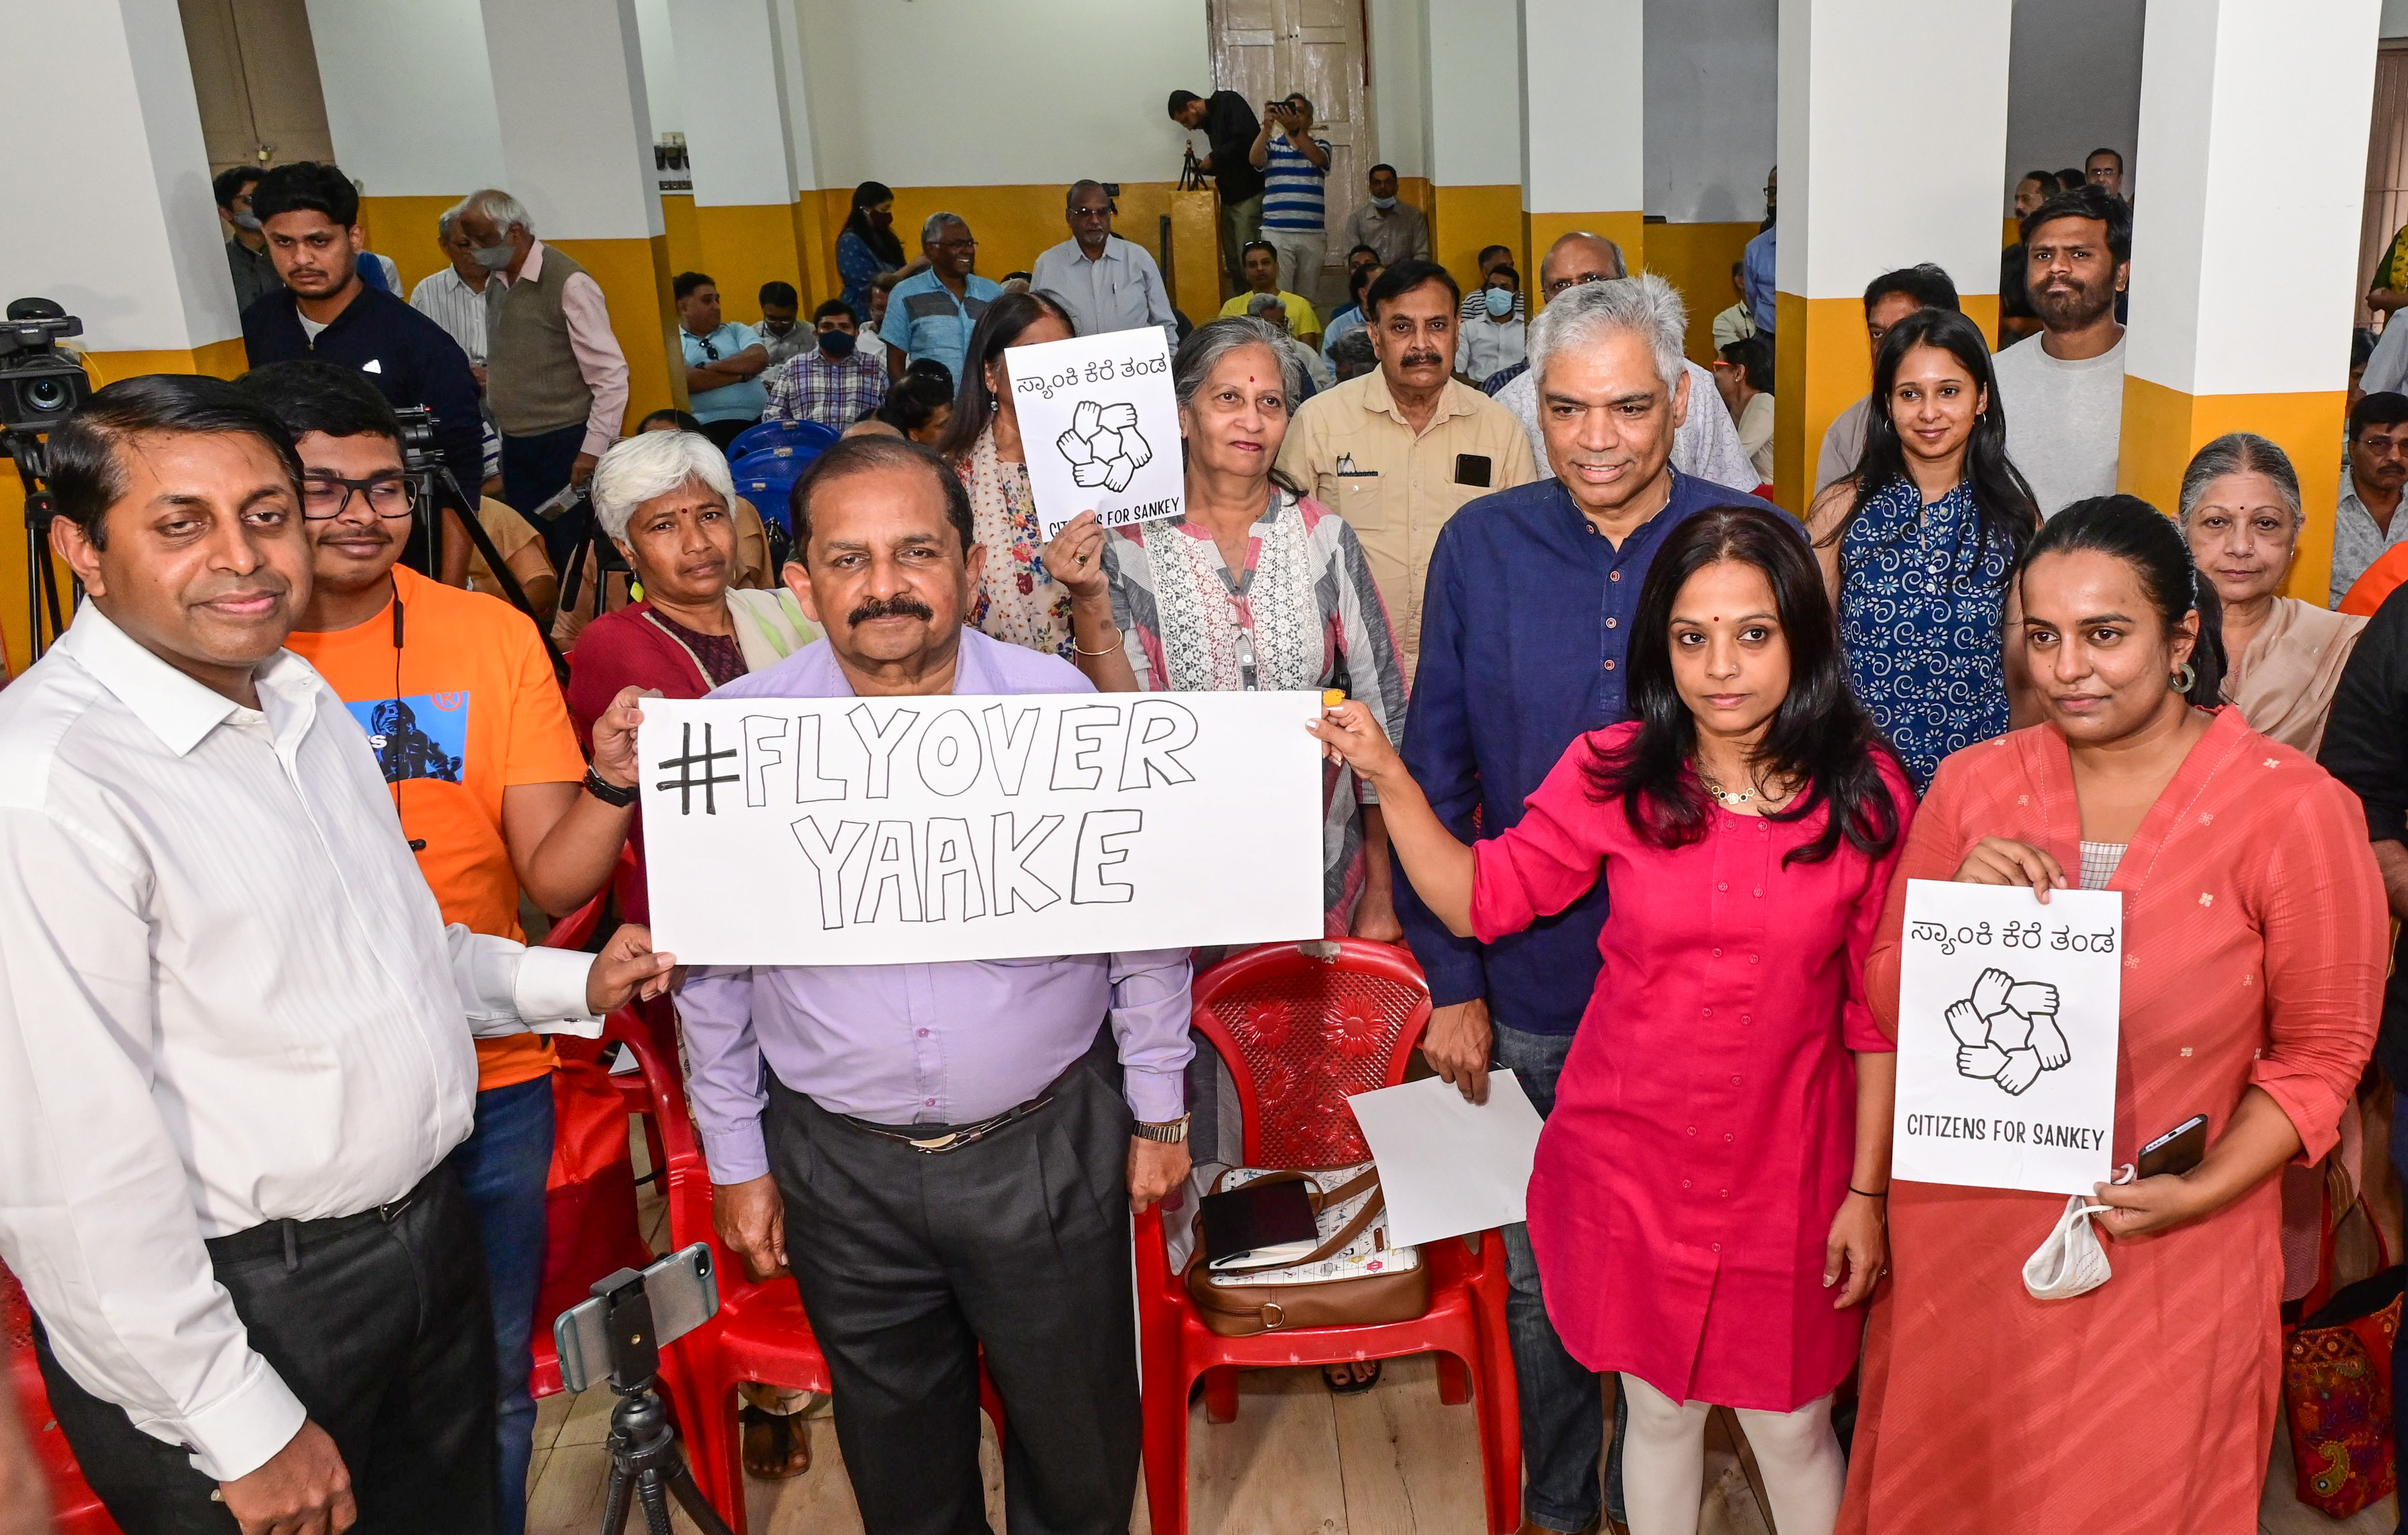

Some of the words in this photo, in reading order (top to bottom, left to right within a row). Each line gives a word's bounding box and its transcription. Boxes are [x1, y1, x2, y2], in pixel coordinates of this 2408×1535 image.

[1016, 367, 1078, 399] ಸ್ಯಾಂಕಿ
[1085, 360, 1114, 383] ಕೆರೆ
[1120, 352, 1167, 377] ತಂಡ
[1107, 508, 1130, 526] FOR
[1133, 497, 1180, 520] SANKEY
[656, 699, 1198, 816] #FLYOVER
[790, 809, 1143, 931] YAAKE
[1911, 920, 1993, 956] ಸ್ಯಾಂಕಿ
[2003, 920, 2042, 949] ಕೆರೆ
[2050, 924, 2114, 954] ತಂಡ
[1907, 1114, 1985, 1140] CITIZENS
[1994, 1120, 2025, 1144] FOR
[2032, 1123, 2105, 1151] SANKEY
